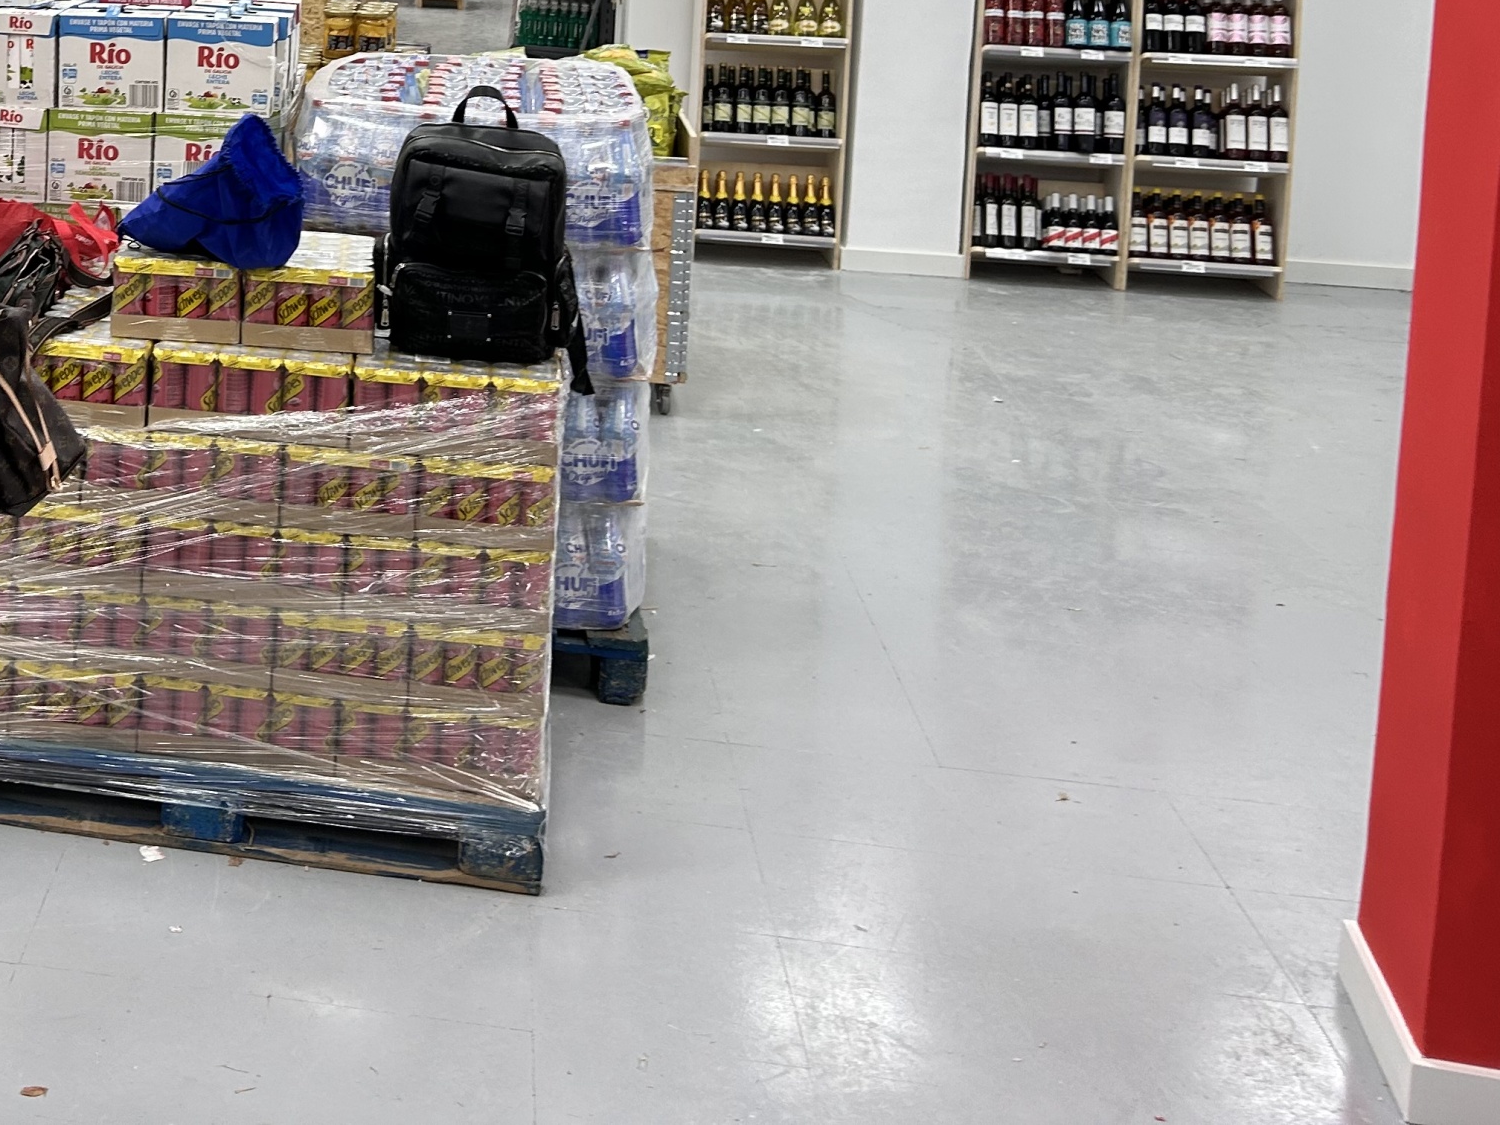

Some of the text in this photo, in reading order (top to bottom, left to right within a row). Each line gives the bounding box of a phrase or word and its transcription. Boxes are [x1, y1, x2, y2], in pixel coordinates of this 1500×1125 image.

[10, 16, 33, 29] Río
[89, 42, 131, 64] Río
[197, 45, 240, 69] Río
[0, 109, 23, 123] Río
[78, 138, 119, 161] Río
